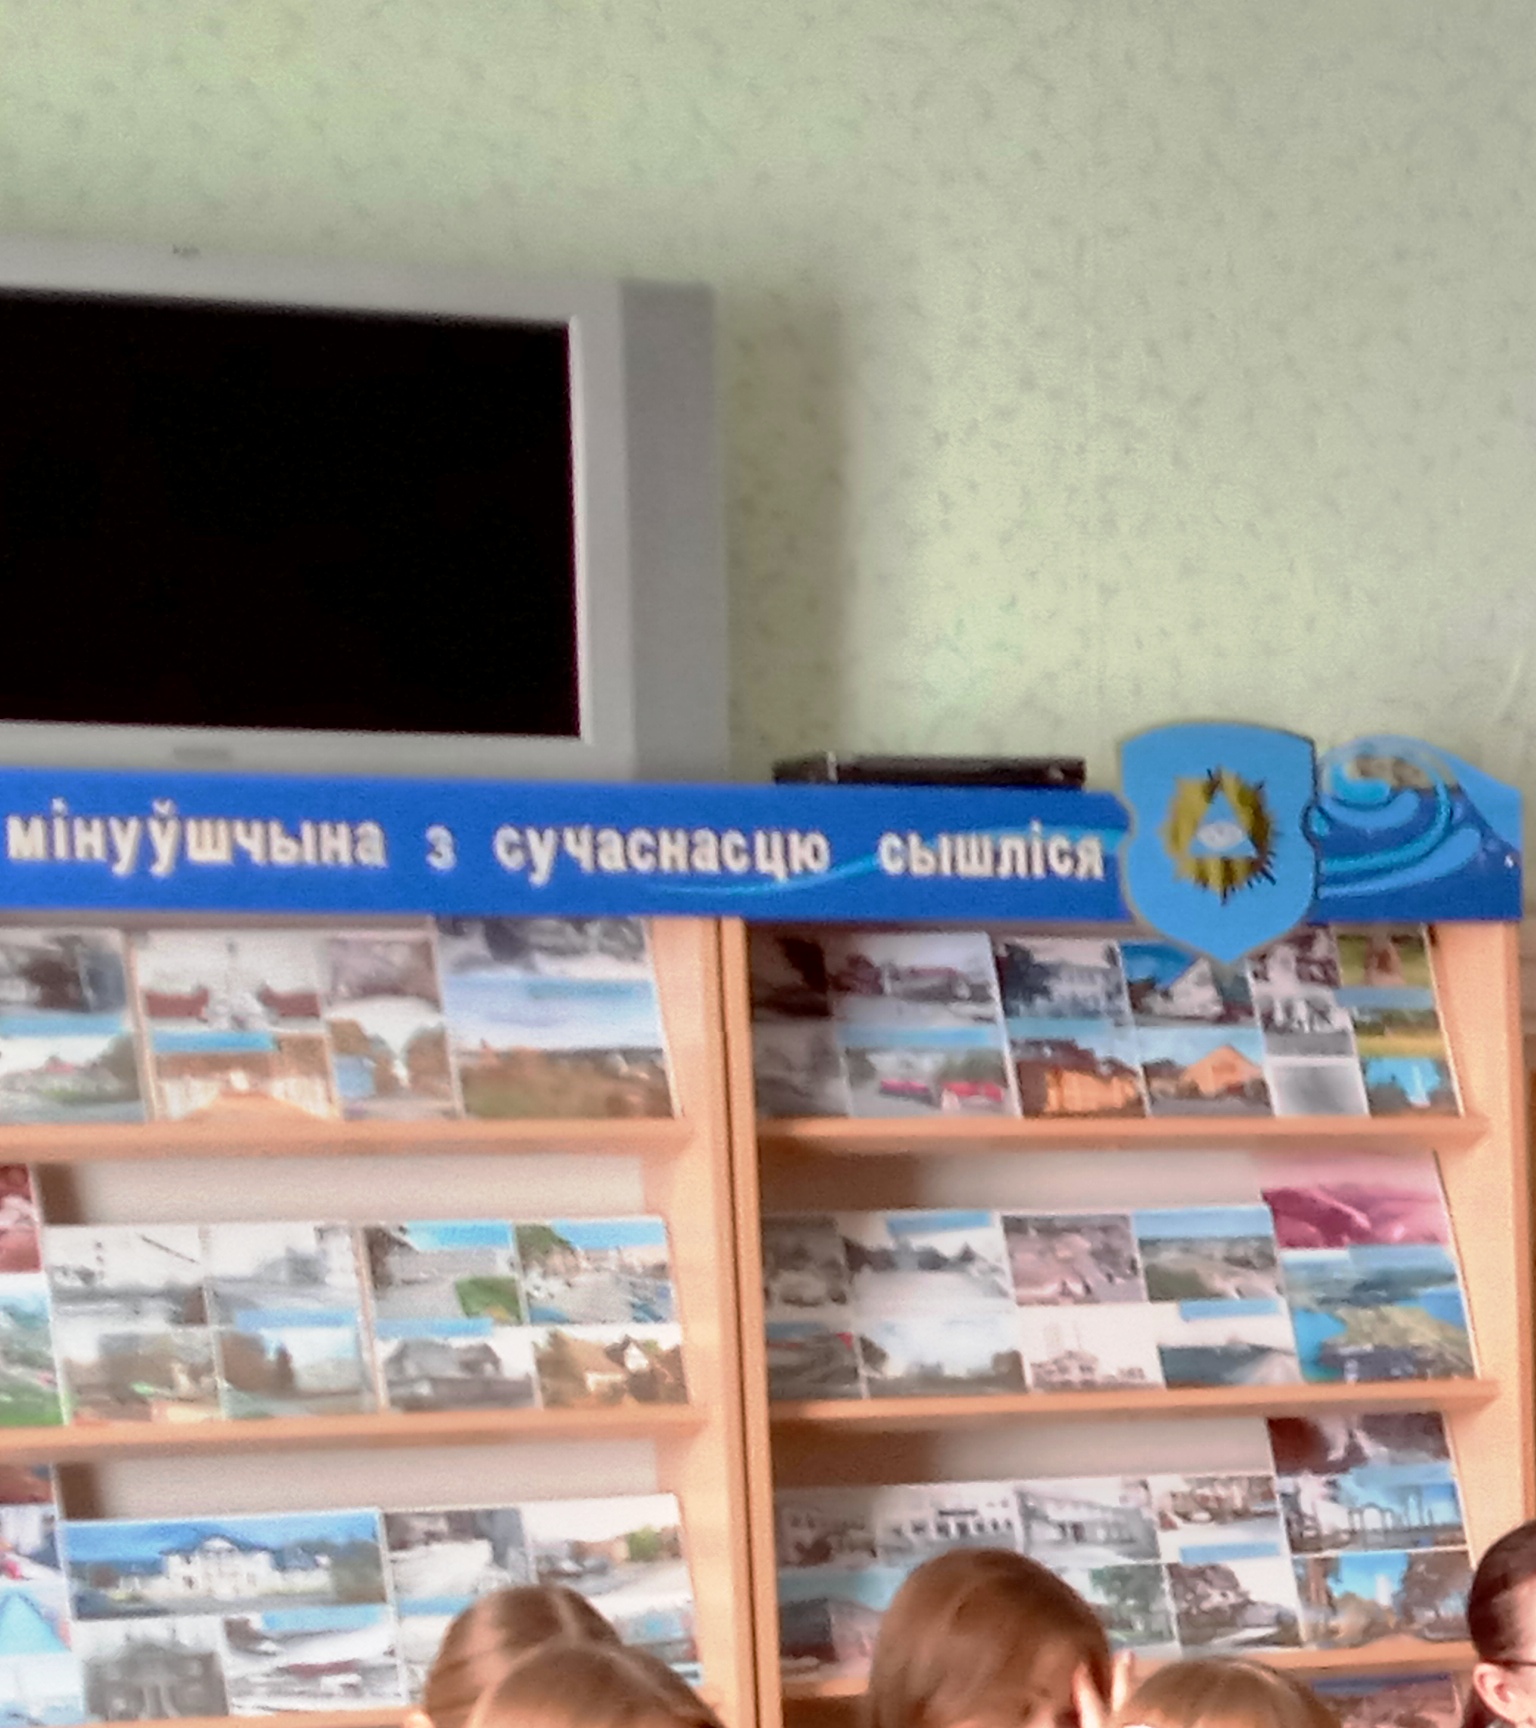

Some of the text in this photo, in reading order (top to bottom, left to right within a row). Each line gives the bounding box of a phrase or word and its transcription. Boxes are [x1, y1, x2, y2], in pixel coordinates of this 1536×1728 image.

[6, 797, 1105, 888] мінуўшчына з сучаснасцю сышліся
